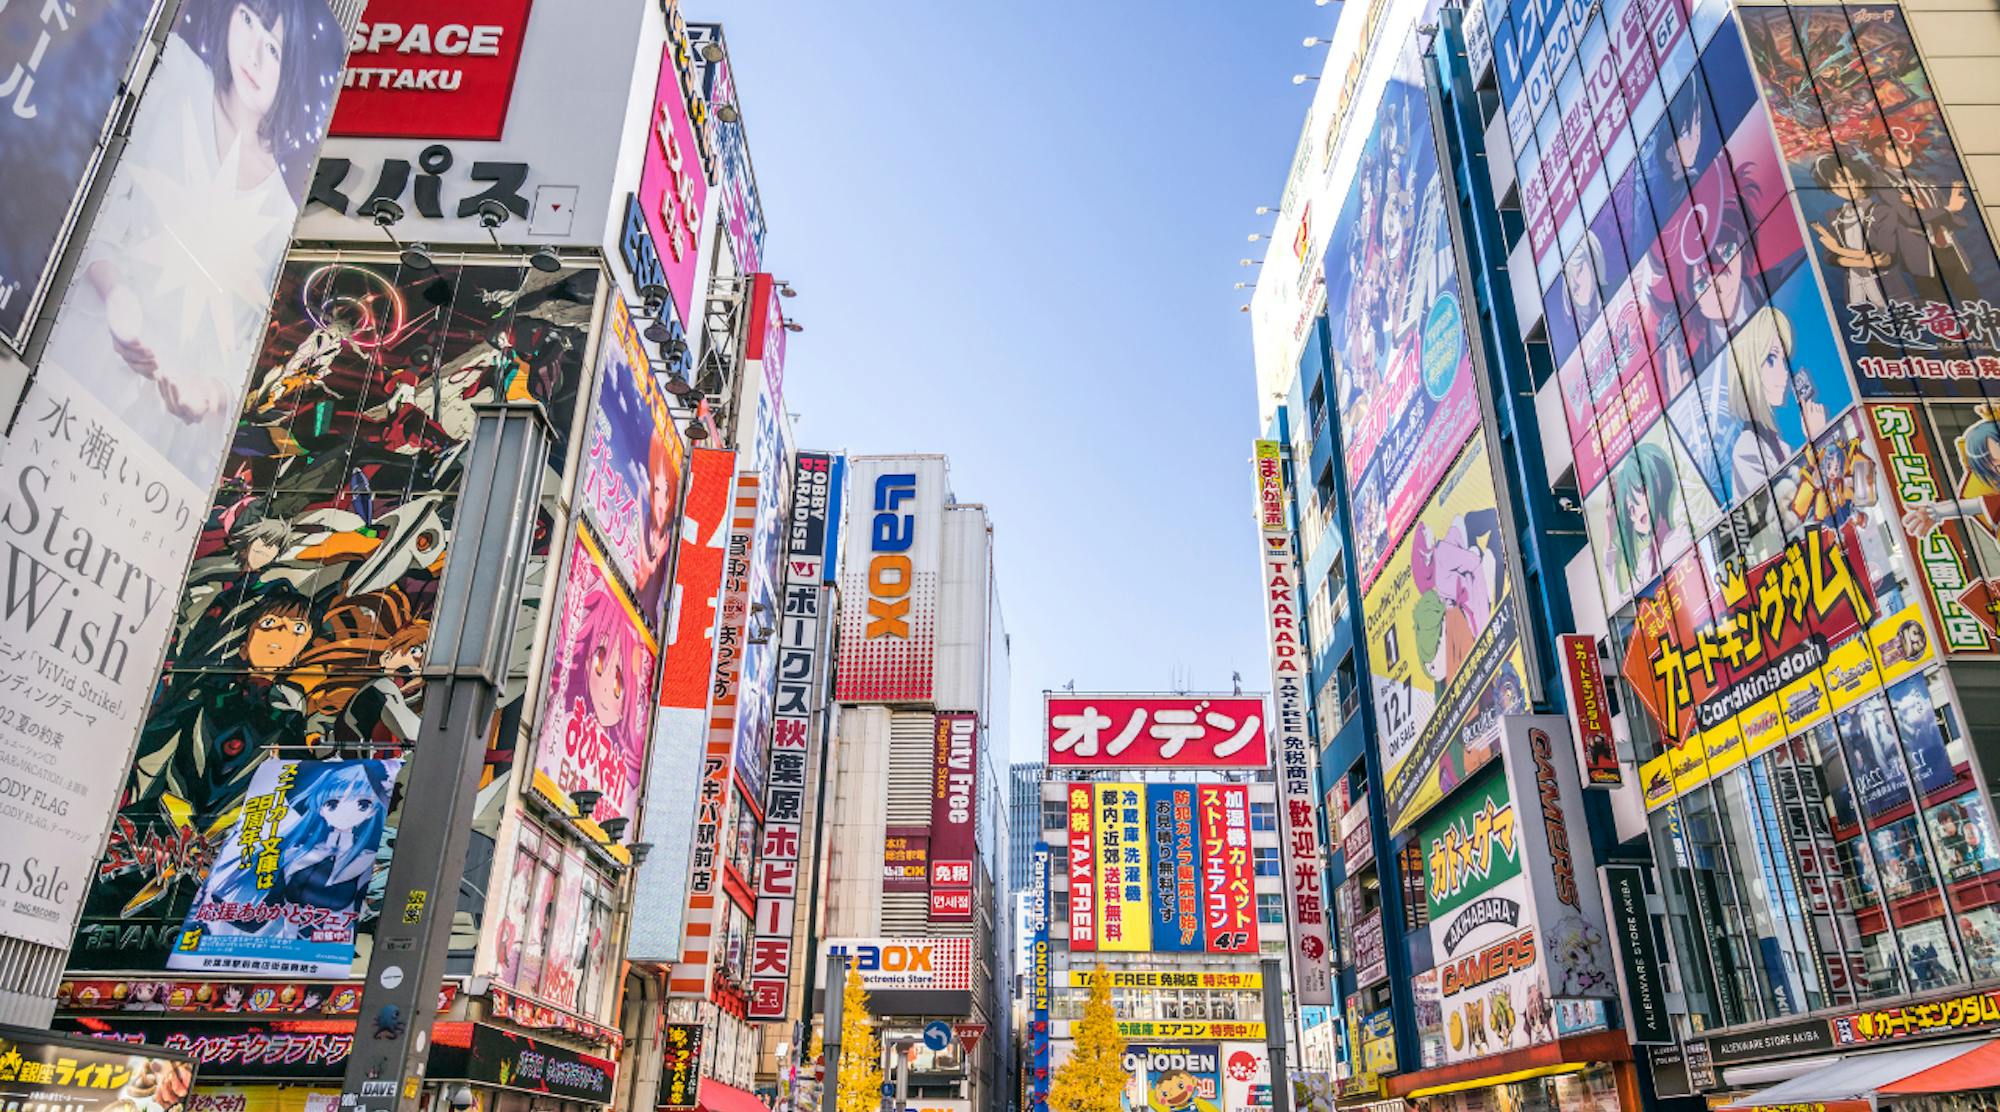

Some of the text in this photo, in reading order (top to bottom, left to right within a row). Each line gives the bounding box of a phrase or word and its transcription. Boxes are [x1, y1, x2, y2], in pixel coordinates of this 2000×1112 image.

[347, 24, 503, 56] SPACE
[1657, 9, 1674, 49] 6F
[343, 68, 463, 91] ITTAKU
[38, 397, 191, 532] 水瀬いのり
[811, 459, 828, 520] HOBBY
[791, 458, 812, 551] PARADISE
[1873, 406, 1988, 650] カードゲム専門店
[1, 465, 167, 634] Starry
[6, 541, 128, 685] Wish
[1269, 562, 1297, 672] TAKARADA
[1654, 525, 1874, 741] カードキングダム
[1384, 675, 1413, 737] 12.7
[1702, 643, 1824, 725] cardkingdom
[937, 719, 950, 799] Flagship Store
[1052, 700, 1261, 759] オノデン
[1399, 722, 1416, 750] SALE
[948, 719, 974, 824] Duty Free
[1284, 736, 1309, 795] 免税商店
[32, 790, 70, 817] FLAG
[255, 763, 298, 891] スニーカー文庫は
[692, 759, 722, 891] アキバ駅前店
[934, 865, 969, 882] 免税
[1071, 789, 1092, 942] 免税 TAX FREE
[1121, 790, 1142, 902] 冷蔵庫 洗濯機
[1288, 799, 1321, 925] 歓迎光臨
[16, 857, 69, 905] Sale
[933, 895, 969, 910] 면세점
[1034, 851, 1047, 931] Panasonic
[195, 902, 359, 928] 応援ありがとうフェア
[1213, 933, 1249, 950] 4F
[1449, 899, 1511, 952] AKIHABARA
[908, 974, 933, 984] Store
[1036, 941, 1048, 1010] ONODEN
[1115, 974, 1156, 986] FREE
[1161, 974, 1198, 987] 免税店
[1442, 930, 1536, 998] GAMERS
[1619, 878, 1657, 1030] ALIENWARE STORE AKIBA
[1117, 1022, 1259, 1038] 冷蔵庫 エアコン 特売中!!
[1720, 1030, 1820, 1055] ALIENWARE STORE AKIBA
[1875, 994, 2000, 1037] カードキングダム
[18, 1057, 131, 1089] 銀座ライオン
[363, 1083, 397, 1096] DAVE
